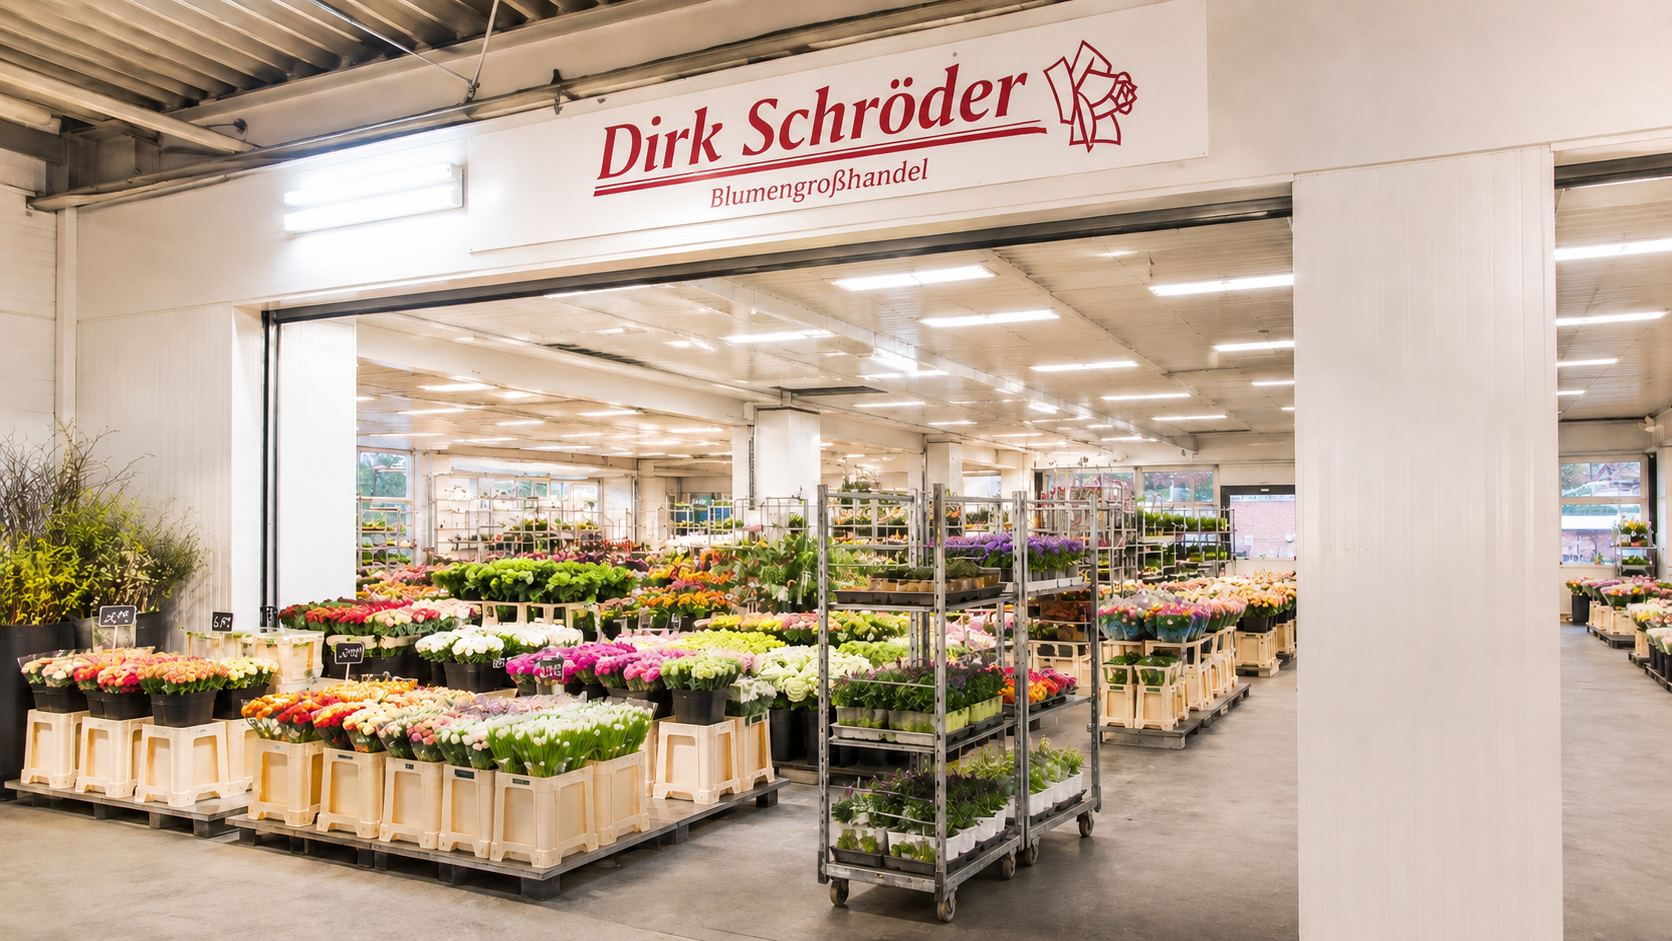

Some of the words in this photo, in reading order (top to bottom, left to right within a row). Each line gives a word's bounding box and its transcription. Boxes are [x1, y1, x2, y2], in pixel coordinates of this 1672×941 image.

[596, 105, 723, 181] Dirk
[741, 63, 1029, 157] Schröder
[709, 157, 929, 209] Blumengroßhandel
